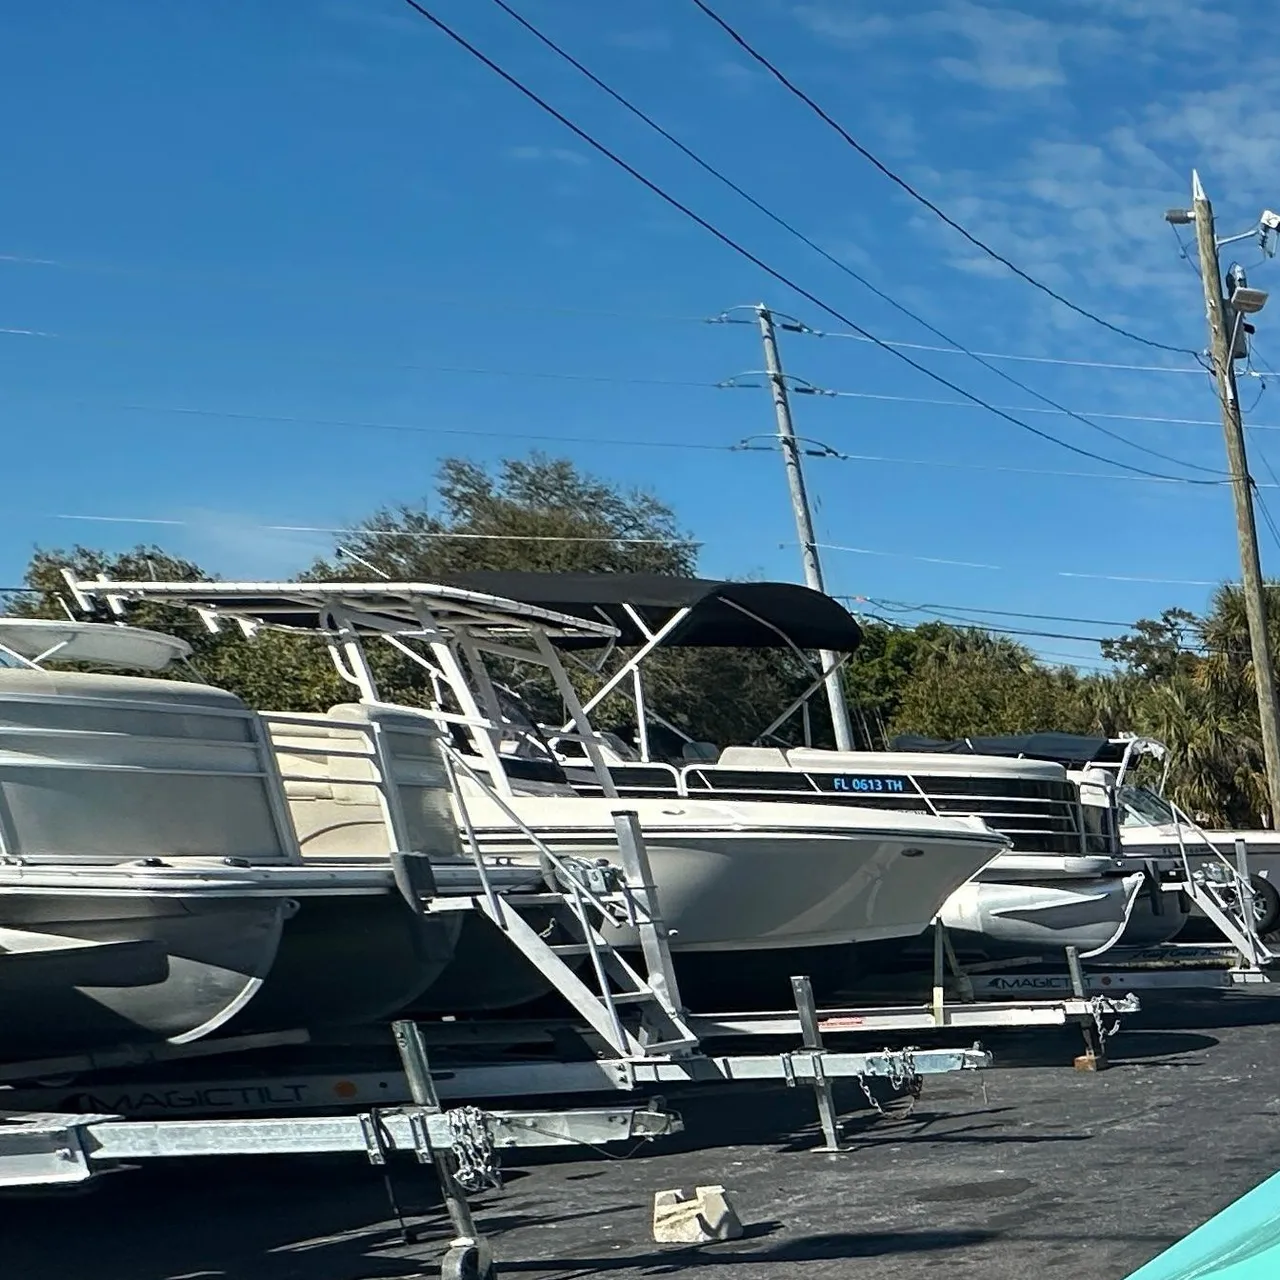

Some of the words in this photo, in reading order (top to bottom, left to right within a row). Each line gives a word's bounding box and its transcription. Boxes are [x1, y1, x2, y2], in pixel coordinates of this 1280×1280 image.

[834, 778, 849, 790] FL
[852, 779, 882, 791] 0613
[886, 780, 903, 791] TH
[88, 1084, 307, 1112] MAGICTILT
